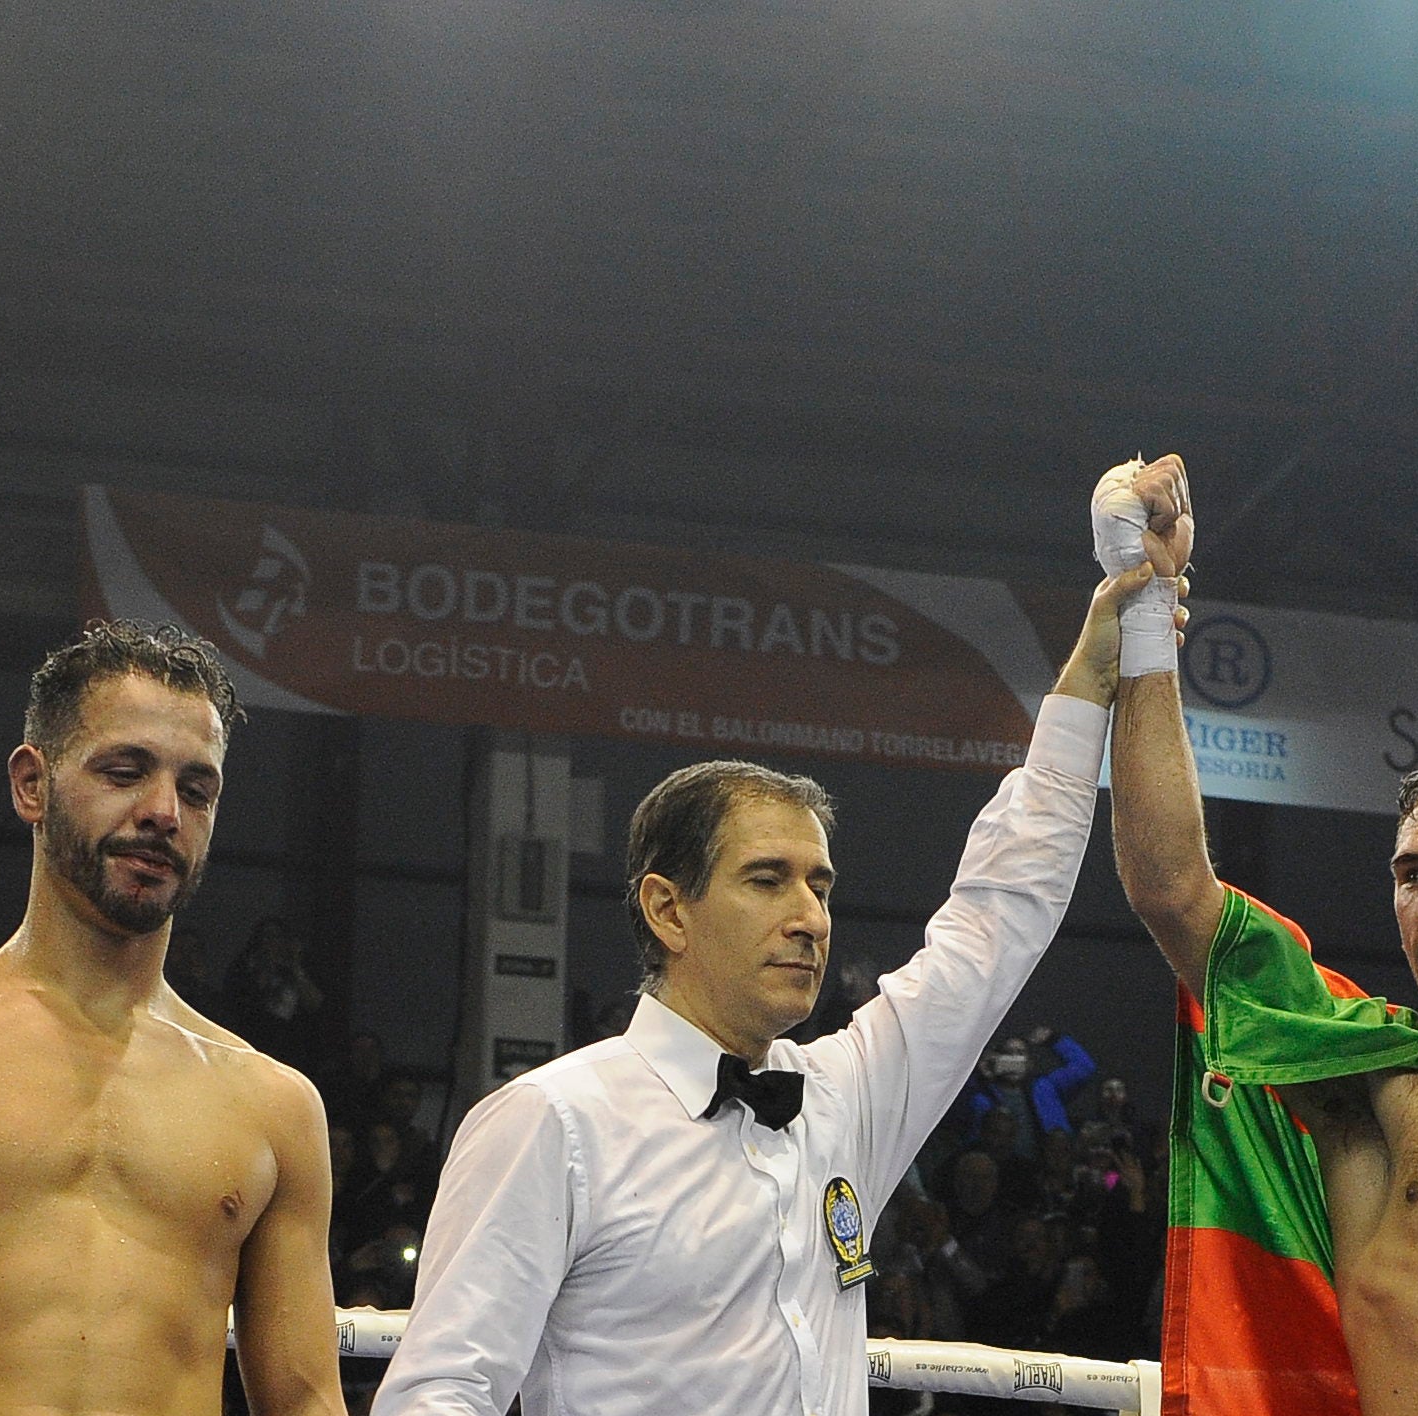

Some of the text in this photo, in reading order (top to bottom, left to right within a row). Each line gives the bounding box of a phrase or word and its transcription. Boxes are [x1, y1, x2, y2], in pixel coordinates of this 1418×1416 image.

[357, 560, 901, 666] BODEGOTRANS
[351, 636, 589, 692] LOGÍSTICA
[872, 731, 1026, 765] TORRELAVEG
[1014, 1359, 1062, 1394] CHARLIE
